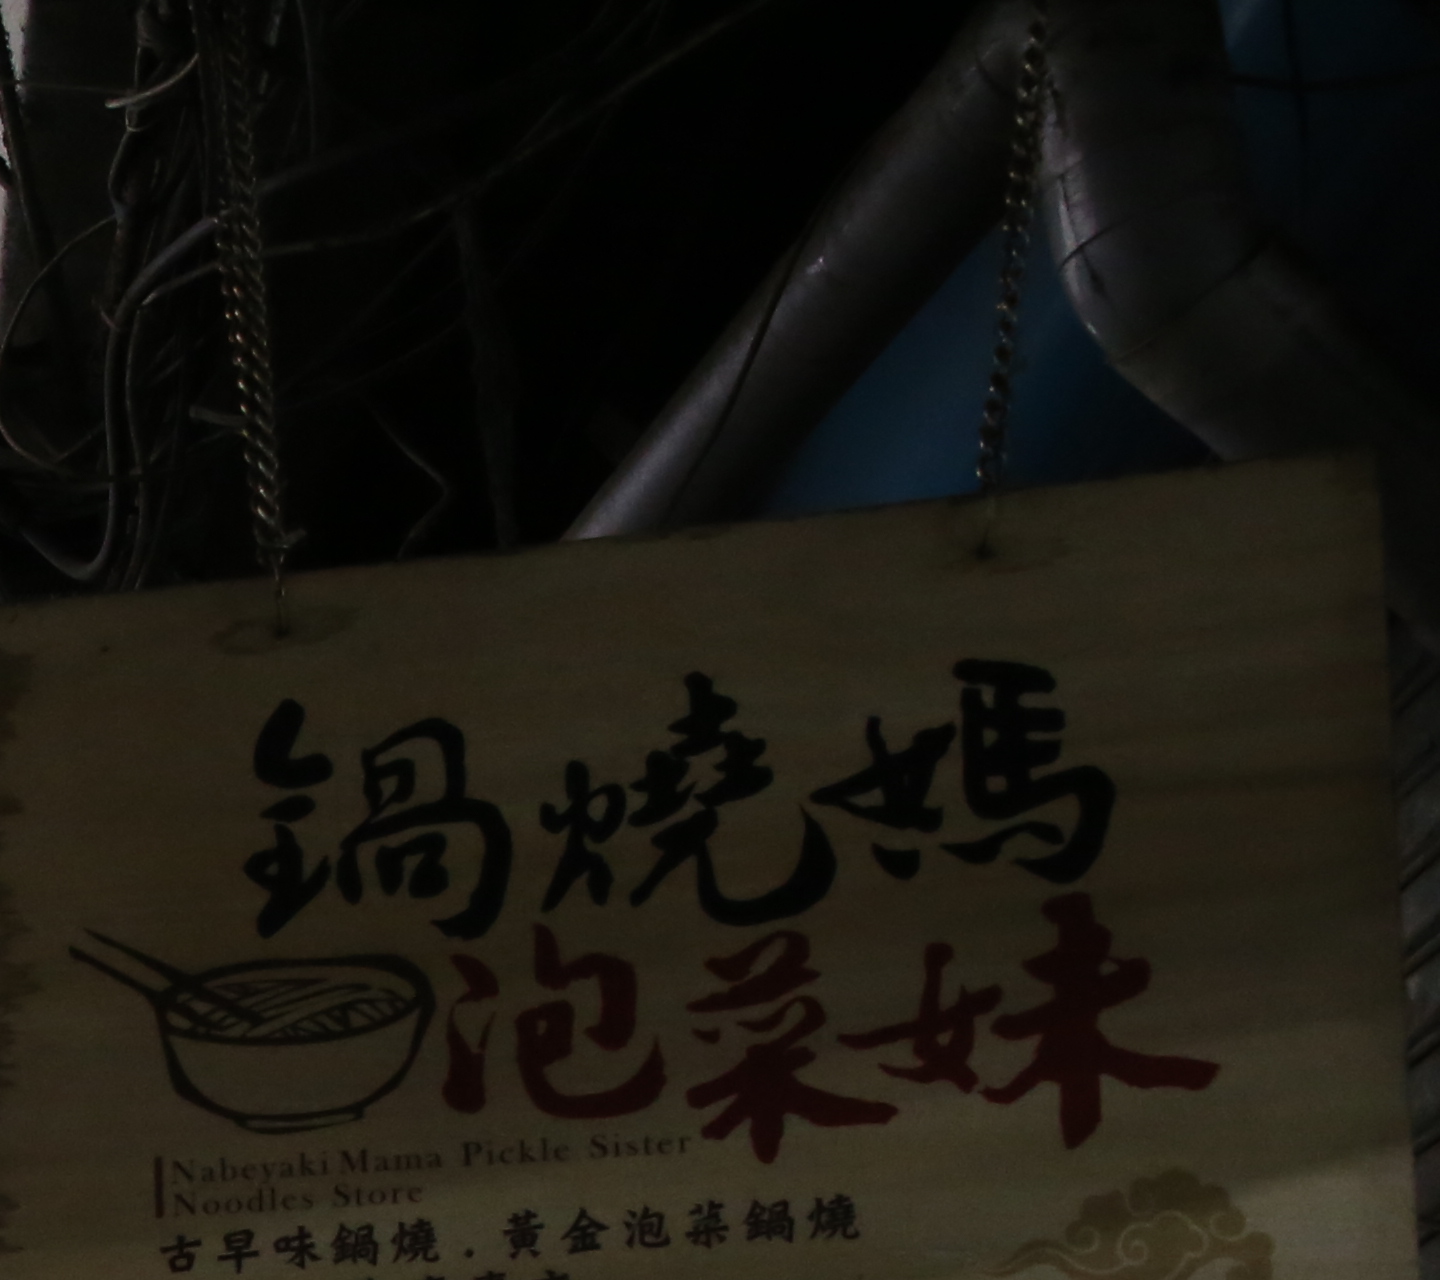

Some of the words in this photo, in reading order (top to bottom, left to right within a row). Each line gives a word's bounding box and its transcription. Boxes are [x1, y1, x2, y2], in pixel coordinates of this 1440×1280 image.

[245, 656, 1118, 941] 鍋燒媽
[443, 894, 1221, 1167] 泡菜妹
[171, 1149, 330, 1190] Nabeyaki
[342, 1148, 444, 1174] Mama
[461, 1138, 571, 1169] Pickle
[589, 1131, 693, 1160] Sister
[172, 1185, 315, 1218] Noodles
[333, 1180, 425, 1208] Store
